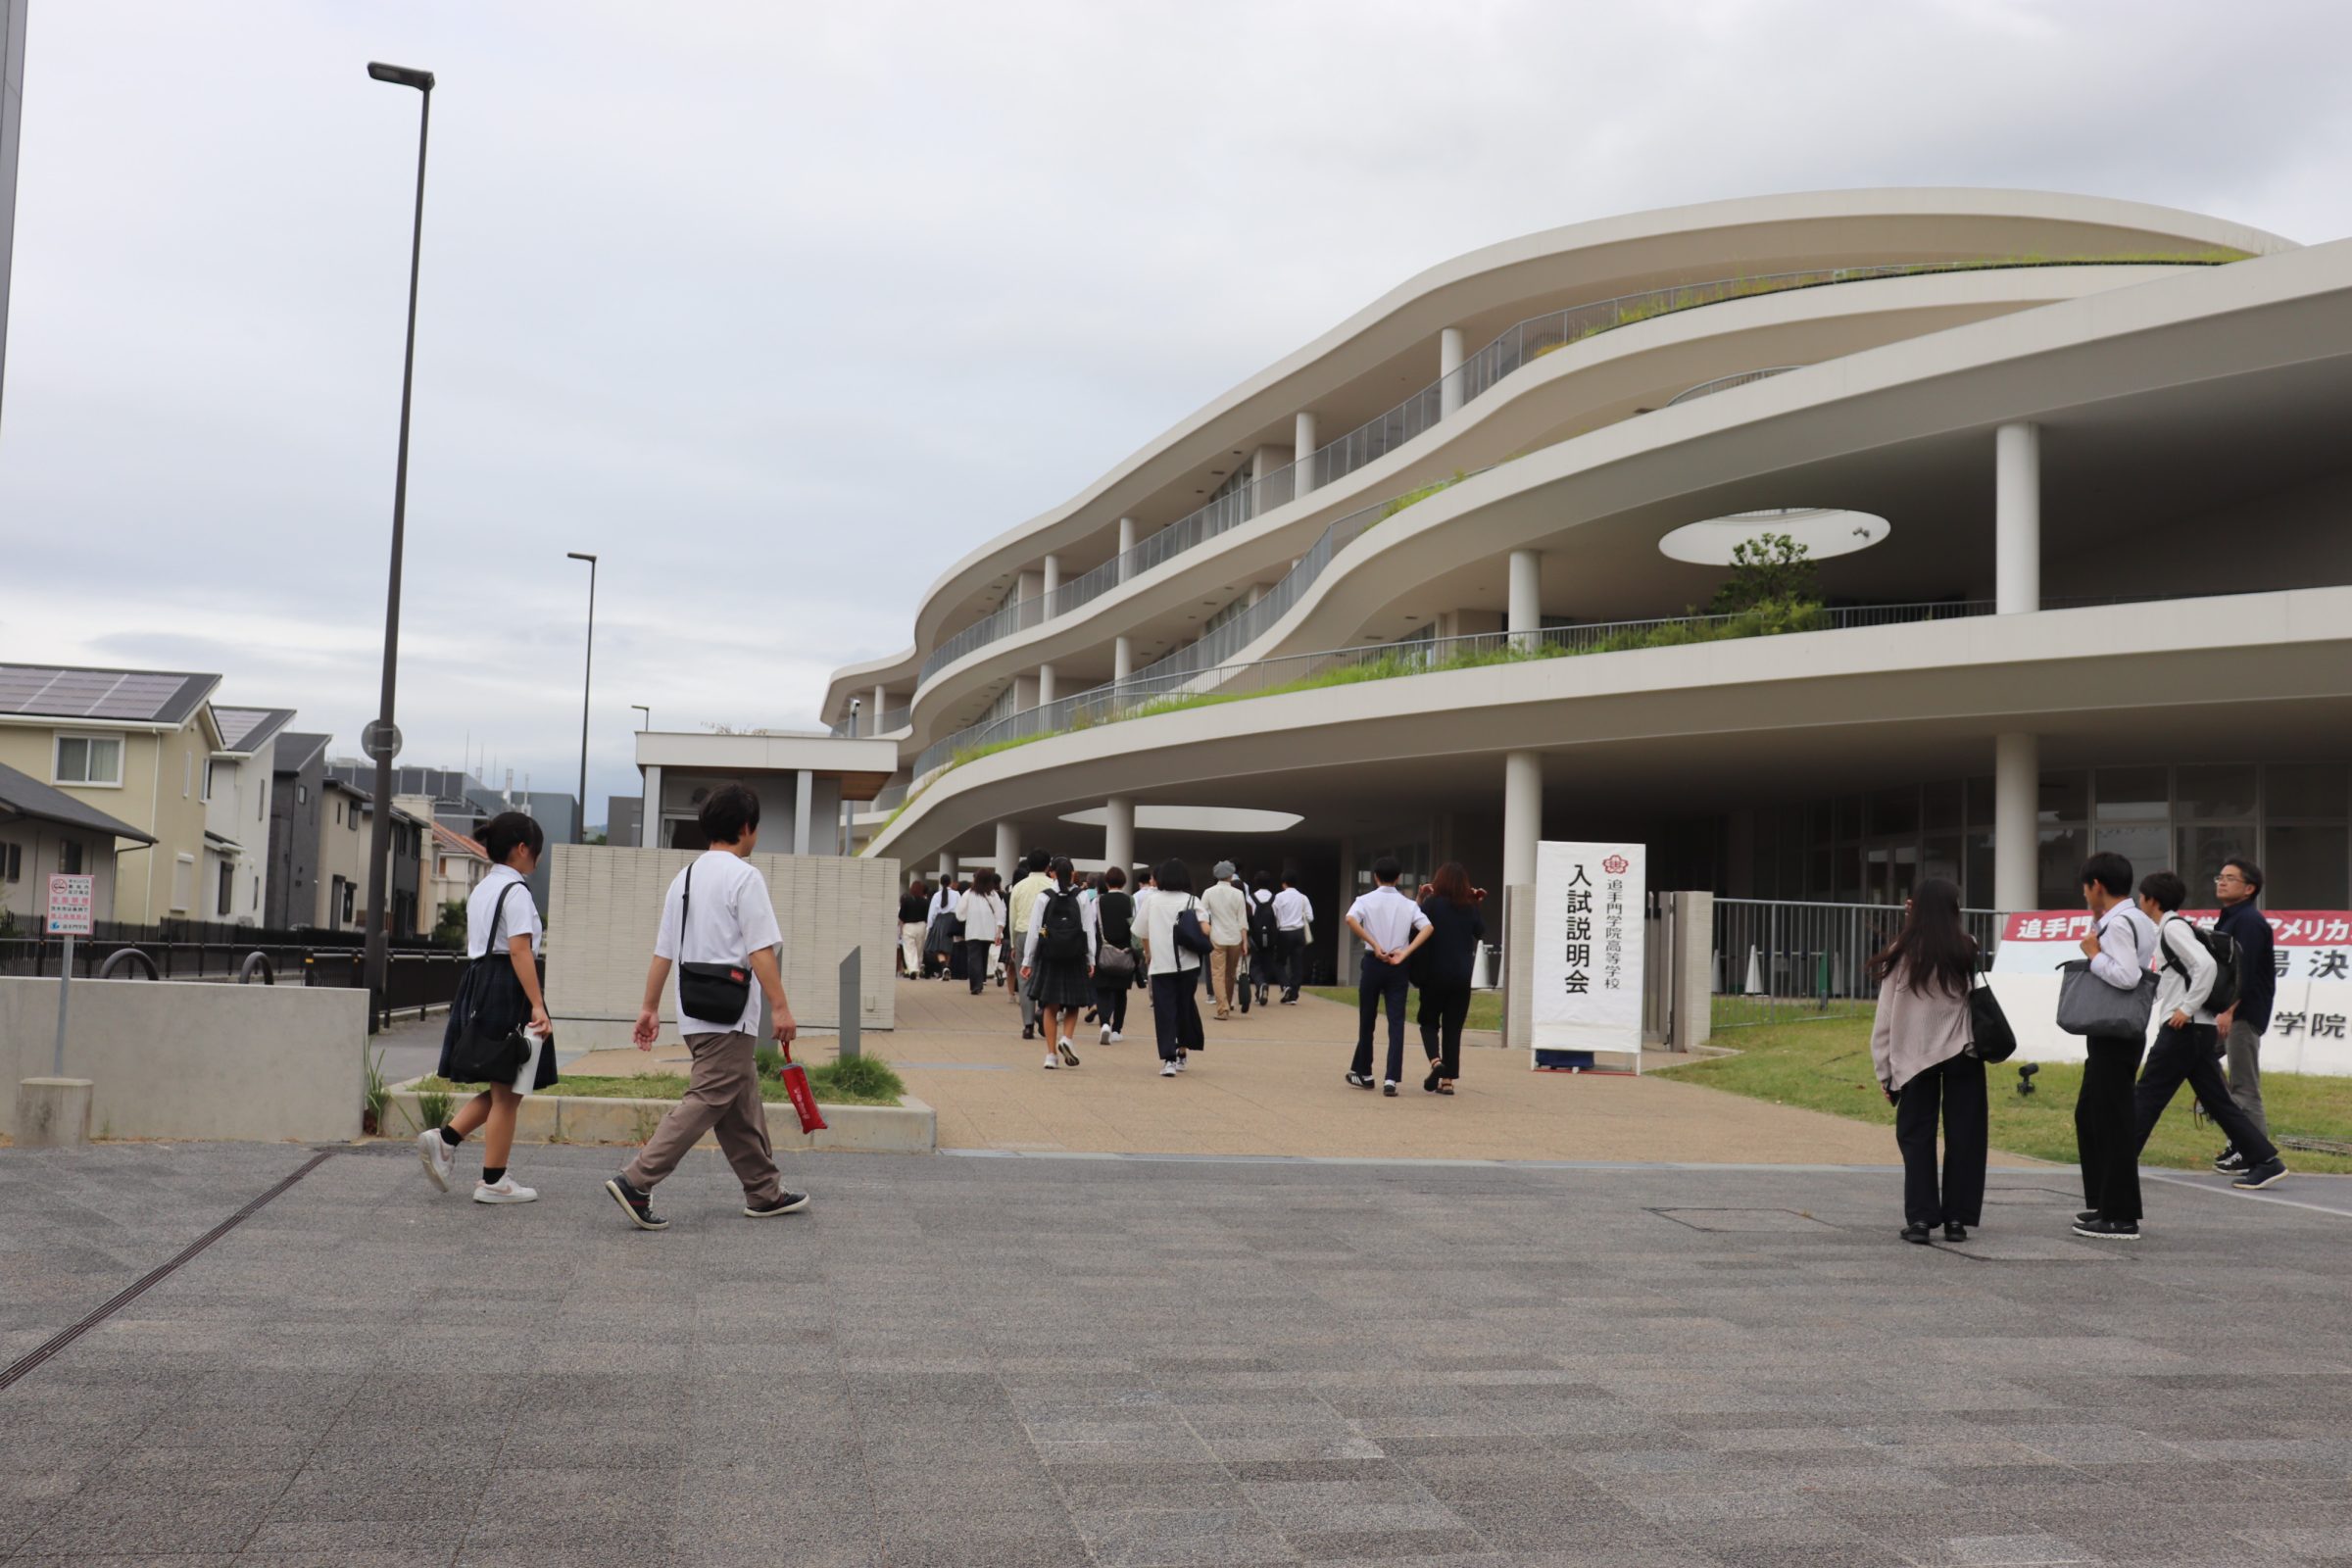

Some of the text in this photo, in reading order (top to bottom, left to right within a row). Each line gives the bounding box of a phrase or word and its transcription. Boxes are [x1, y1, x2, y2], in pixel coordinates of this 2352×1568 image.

[1565, 863, 1592, 994] 入試説明会
[1605, 878, 1623, 990] 追手門学院高等学校
[2266, 917, 2352, 942] アメリカ
[2273, 1011, 2346, 1038] 学院
